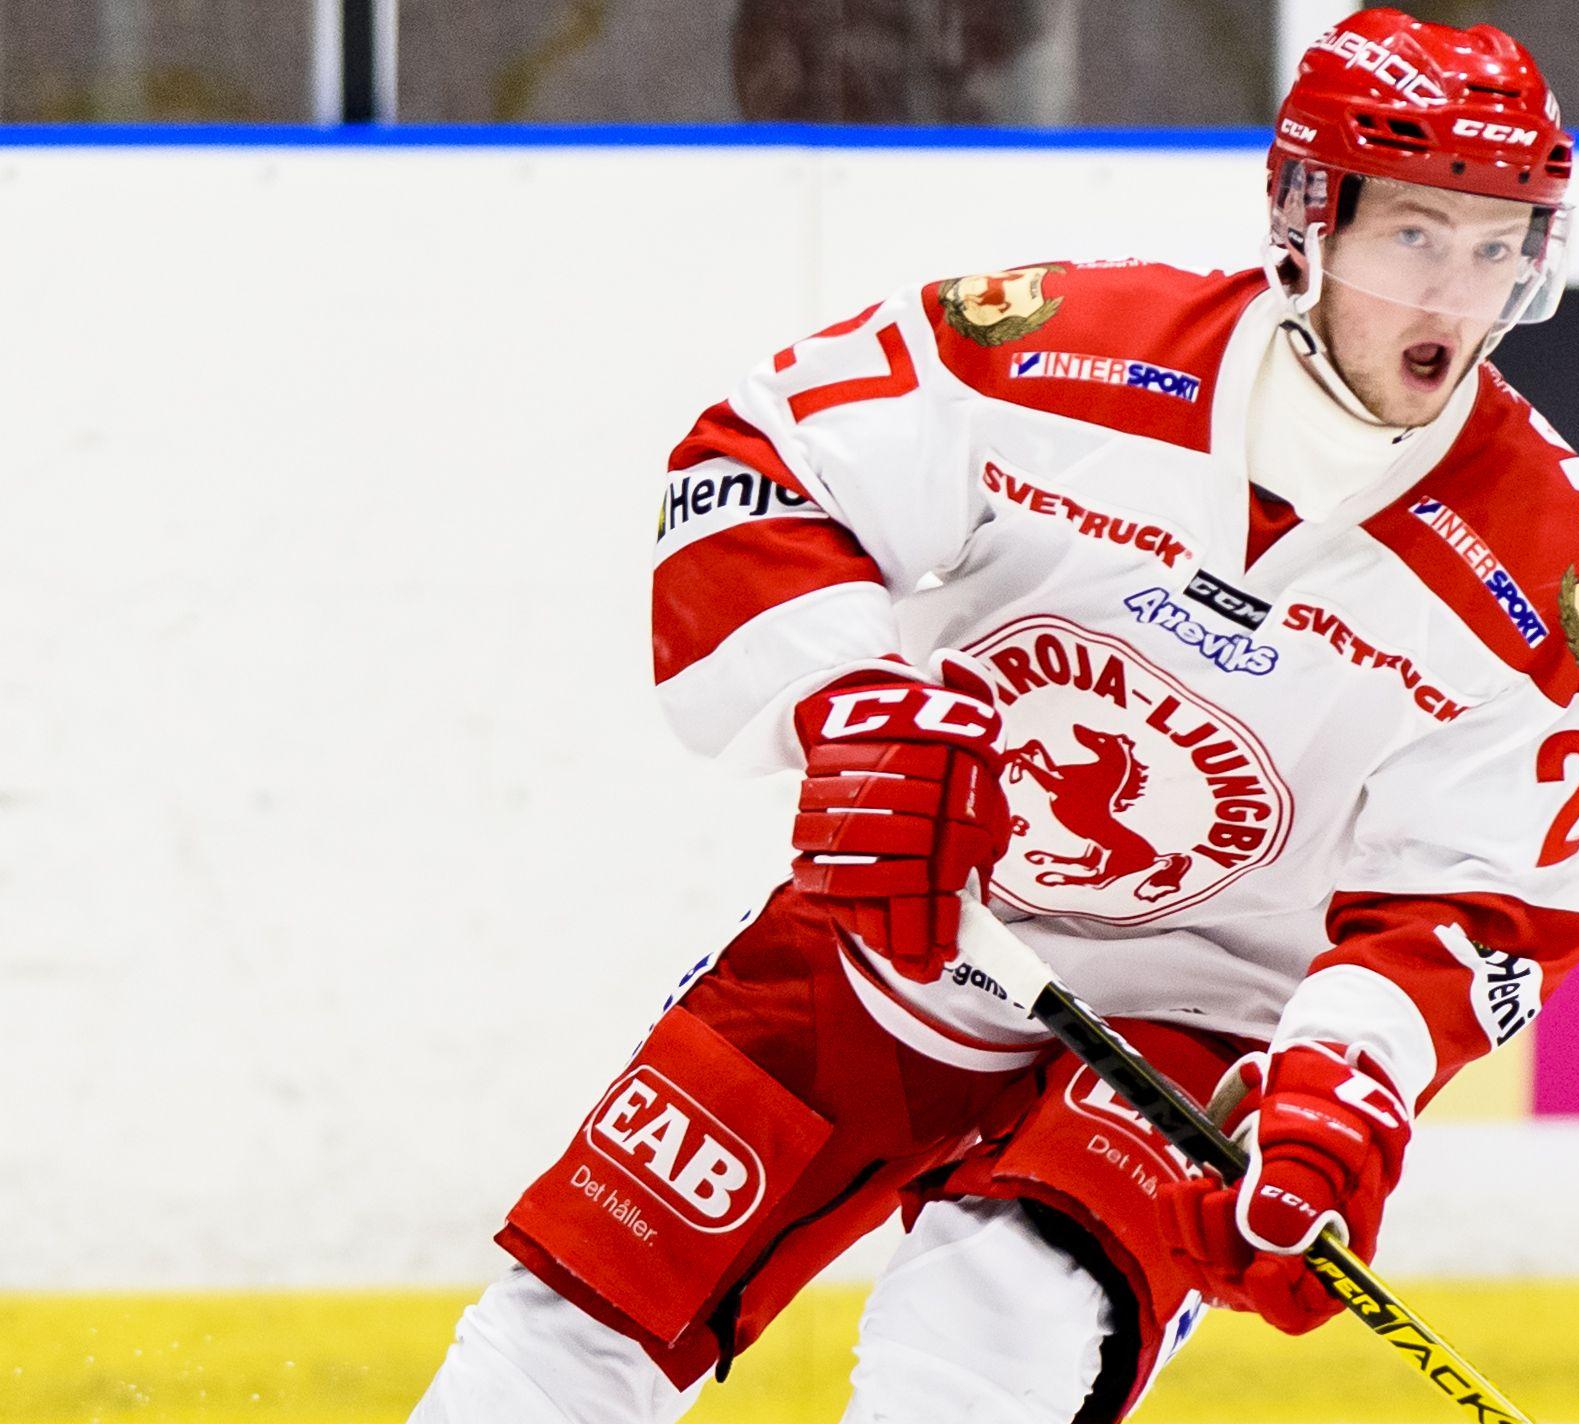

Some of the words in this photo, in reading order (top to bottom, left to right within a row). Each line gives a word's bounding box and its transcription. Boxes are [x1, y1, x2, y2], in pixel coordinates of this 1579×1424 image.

[1281, 118, 1317, 143] CCM
[1452, 118, 1538, 146] CCM
[1044, 351, 1199, 401] INTERSPORT
[1188, 575, 1268, 623] CCM
[1430, 507, 1548, 644] INTERSPORT
[820, 688, 1004, 755] CC
[984, 633, 1273, 870] ROJA-LJUNGBY
[596, 1078, 769, 1218] EAB
[1086, 1134, 1130, 1170] Det
[570, 1164, 605, 1200] Det
[600, 1188, 658, 1247] håller.
[1260, 1184, 1318, 1217] CCM
